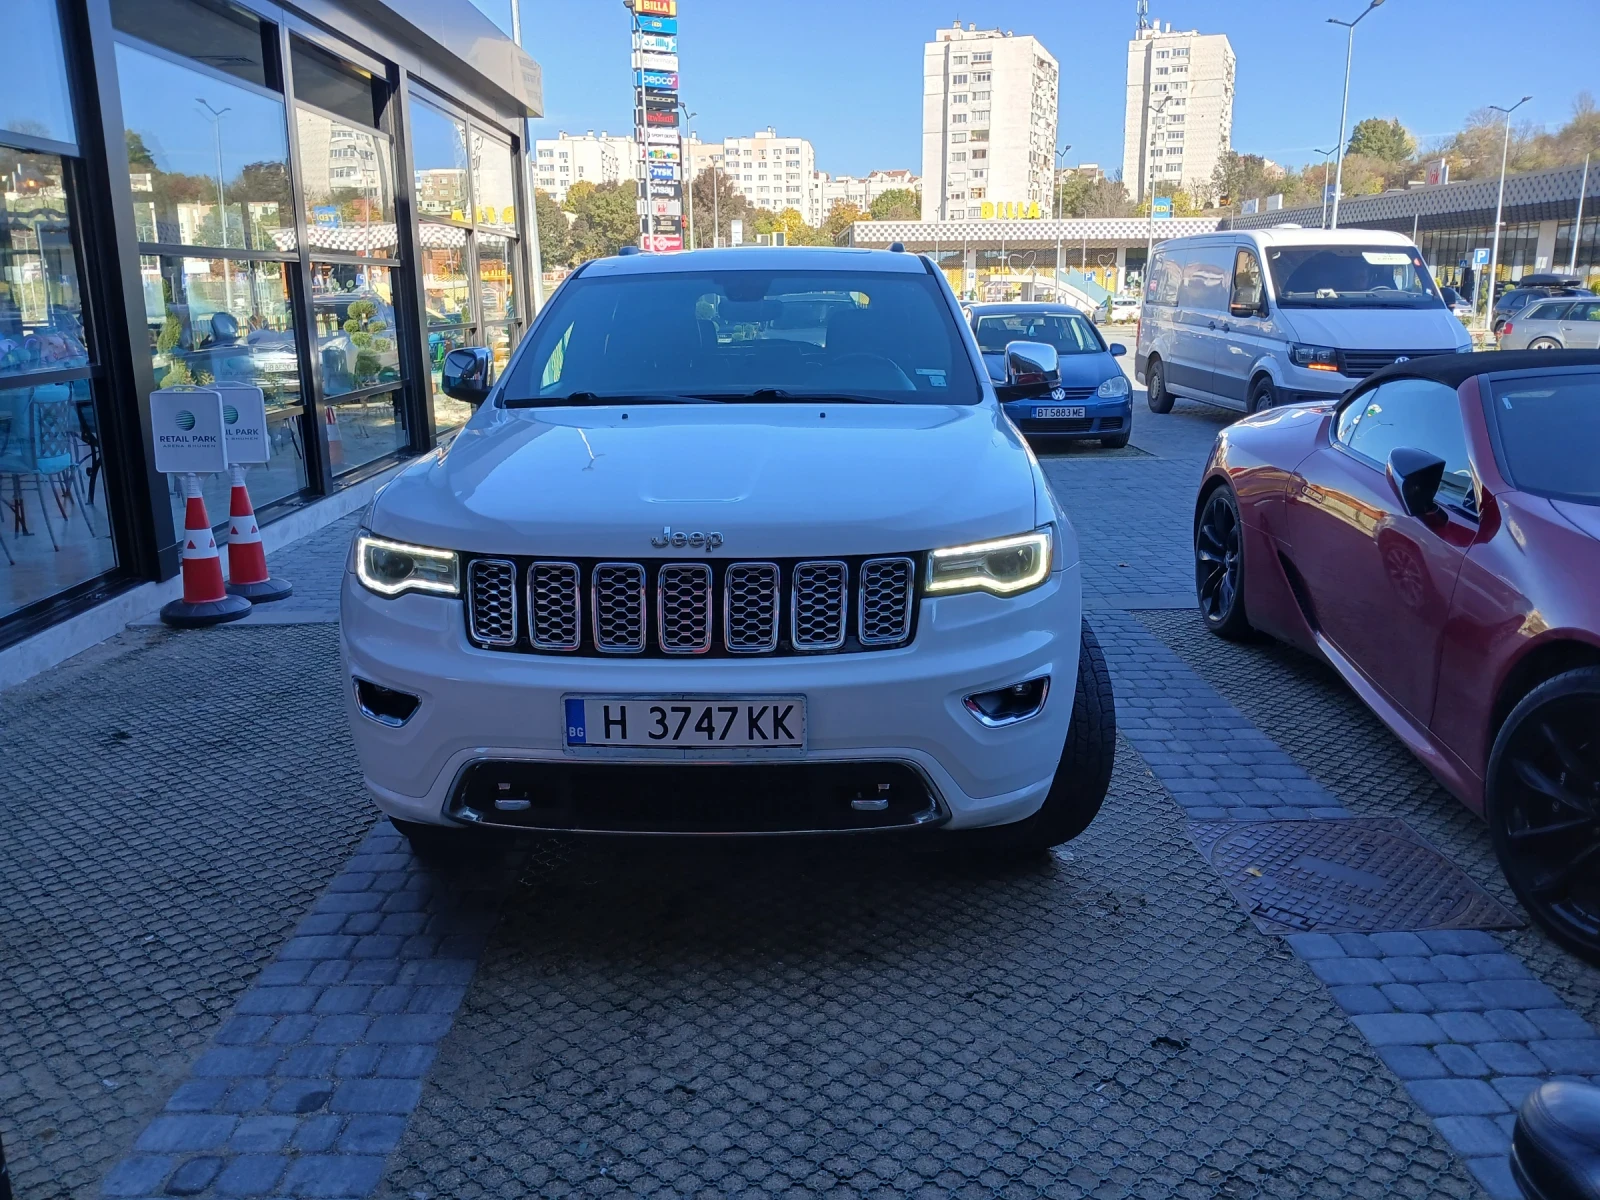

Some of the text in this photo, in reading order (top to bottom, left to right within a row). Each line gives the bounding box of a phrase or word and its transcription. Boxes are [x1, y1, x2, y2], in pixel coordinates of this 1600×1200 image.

[644, 0, 669, 12] BILLA
[652, 168, 673, 177] JYSK
[981, 202, 1039, 219] BILLA
[1050, 408, 1071, 417] 5883
[160, 435, 217, 443] RETAIL PARK
[650, 526, 724, 553] Jeep
[568, 705, 795, 740] BG H 3747 KK
